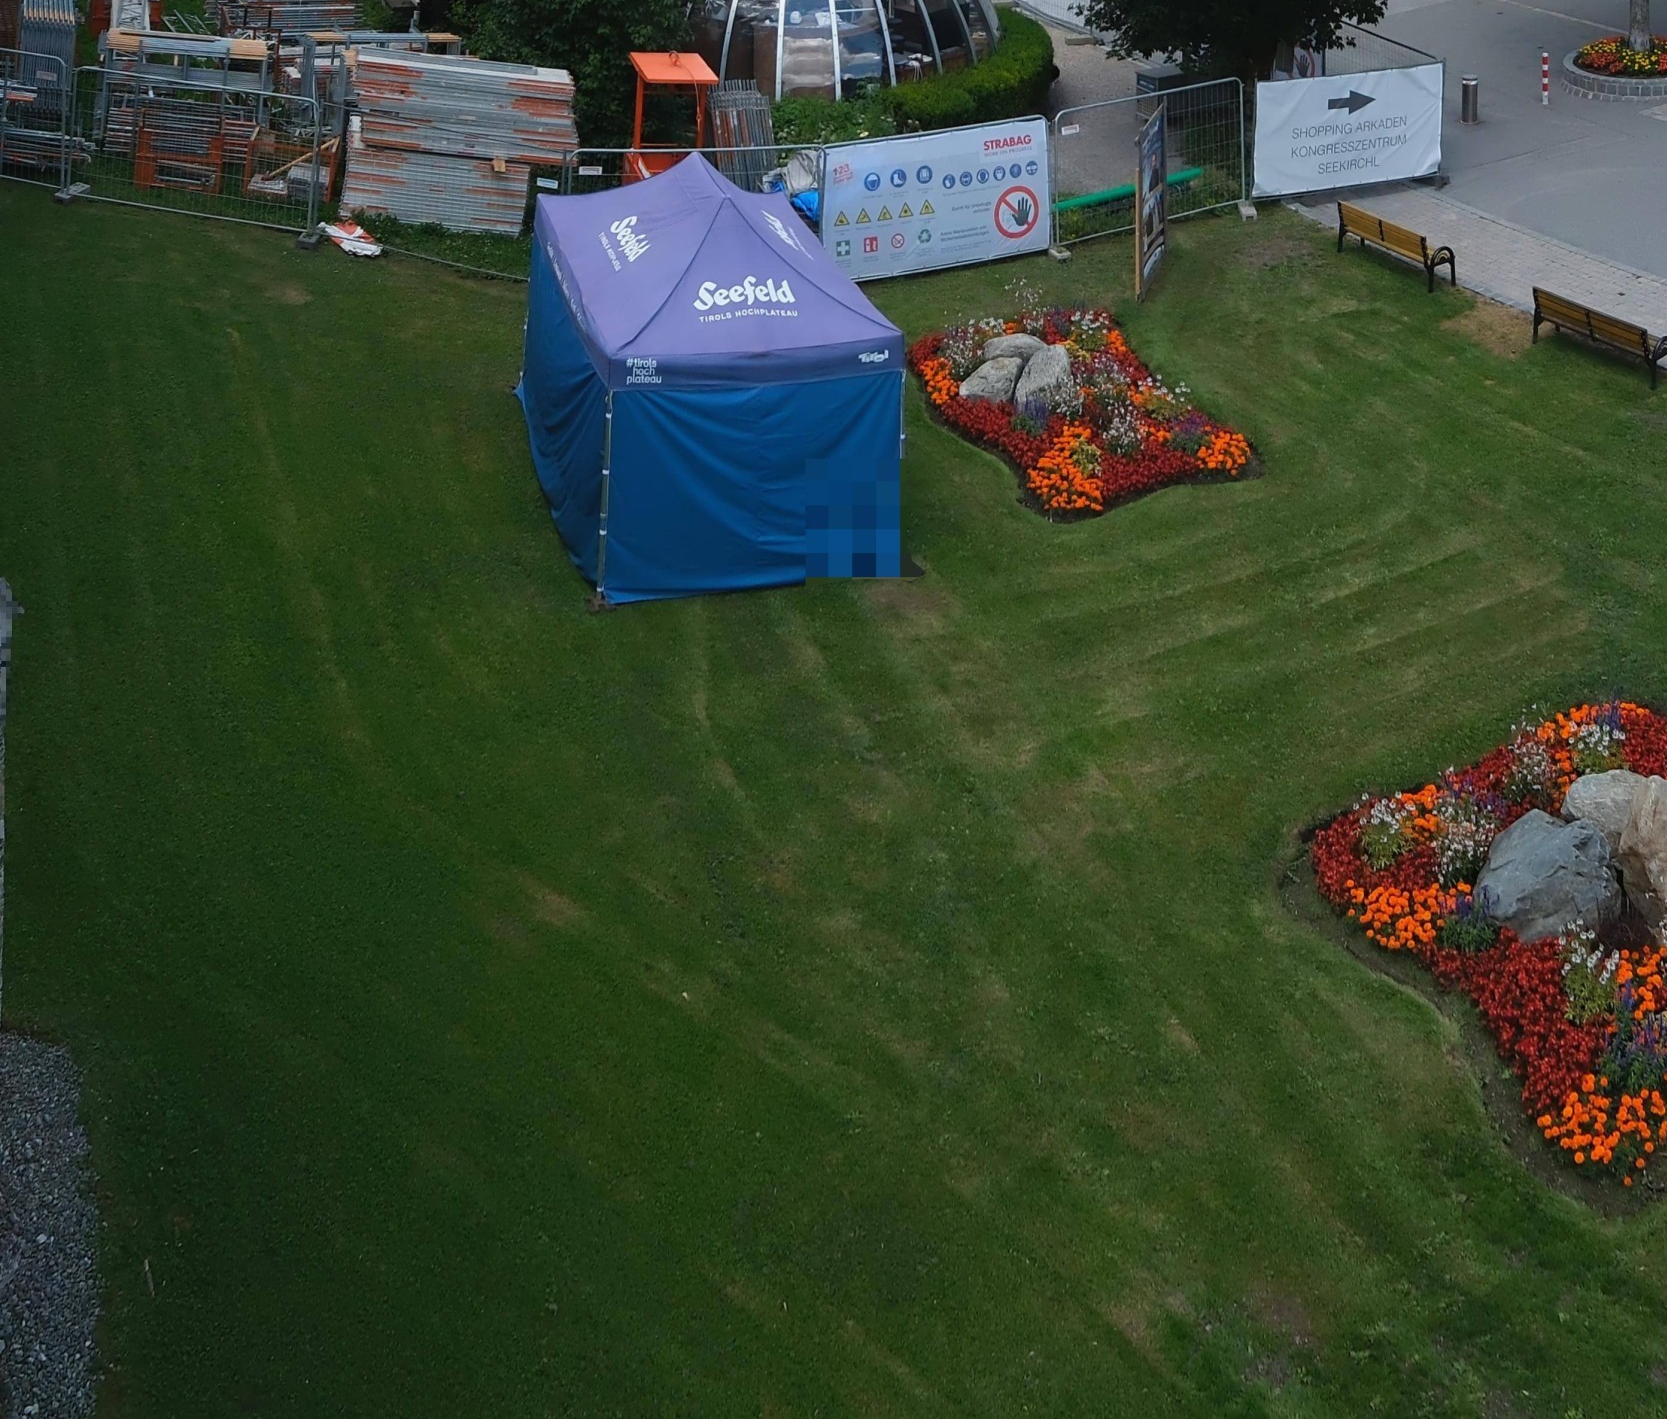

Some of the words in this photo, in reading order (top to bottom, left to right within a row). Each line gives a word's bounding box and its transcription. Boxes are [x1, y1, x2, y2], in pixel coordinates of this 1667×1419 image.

[1291, 122, 1353, 140] SHOPPING
[1355, 115, 1408, 135] ARKADEN
[983, 134, 1032, 151] STRABAG
[1290, 133, 1408, 159] KONGRESSZENTRUM
[1317, 156, 1380, 175] SEEKIRCHL
[609, 214, 651, 263] Seefeld
[693, 275, 797, 312] Seefeld
[698, 310, 733, 324] TIROLS
[734, 308, 798, 319] HOCHPLATEAU
[626, 357, 658, 370] #tirols
[633, 366, 656, 377] hoch
[626, 374, 662, 386] plateau
